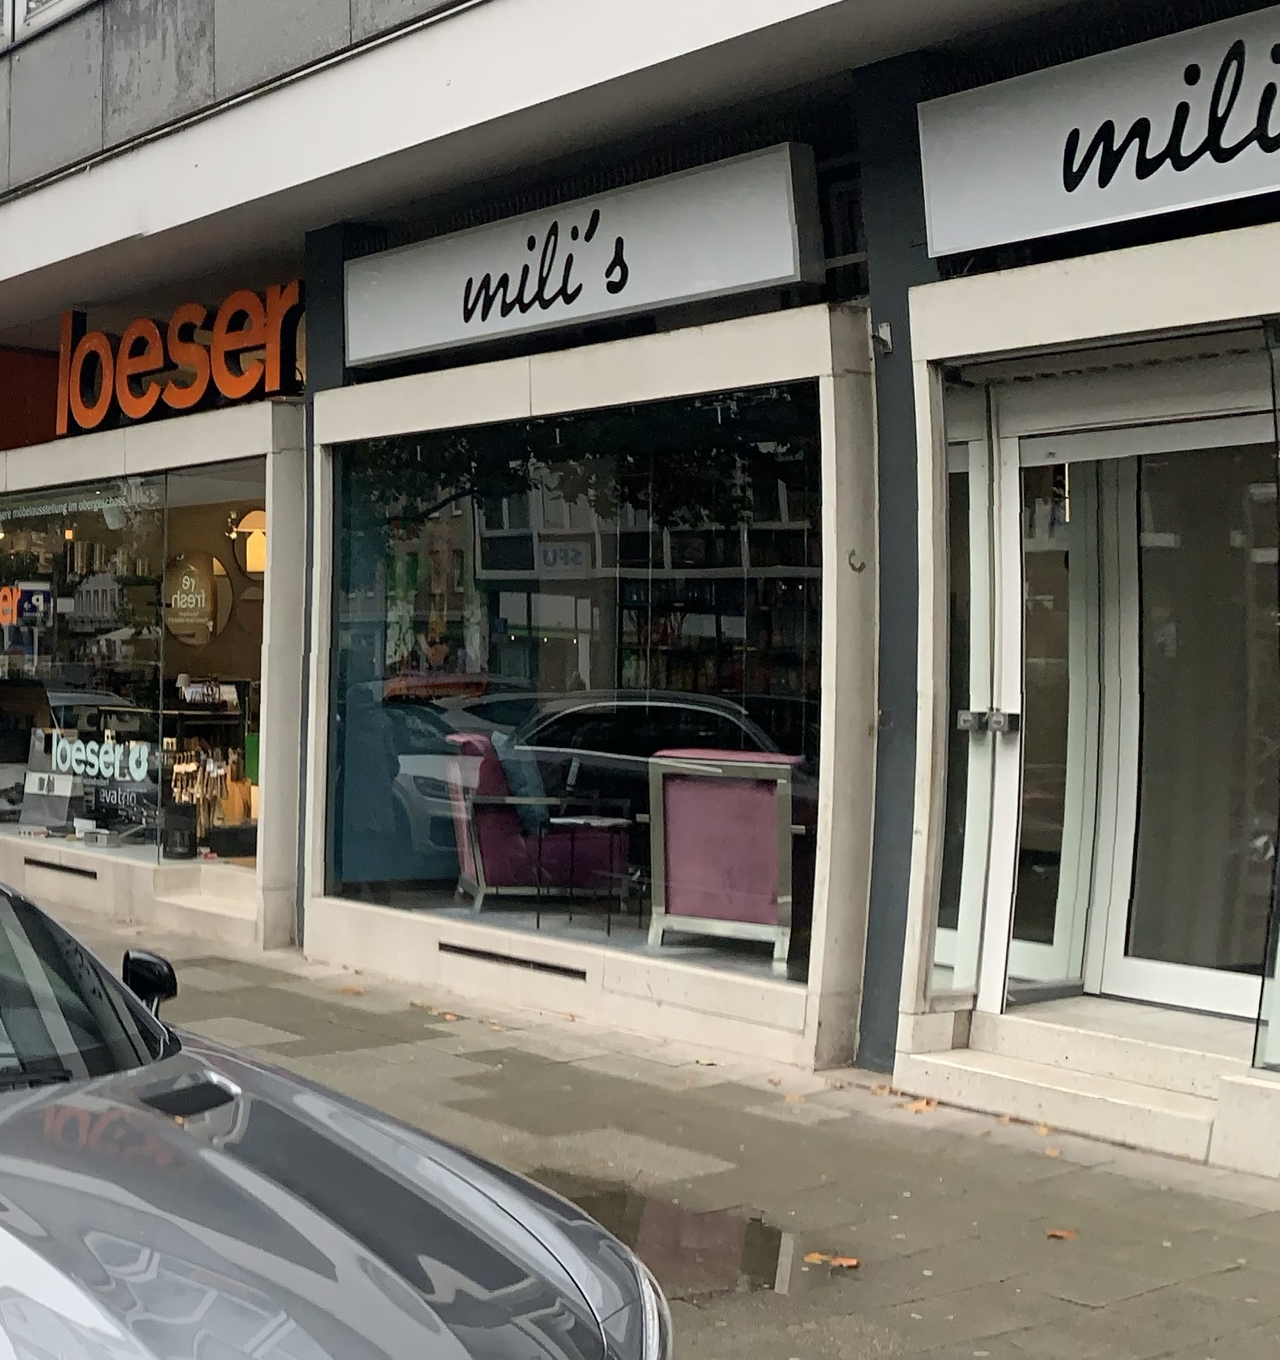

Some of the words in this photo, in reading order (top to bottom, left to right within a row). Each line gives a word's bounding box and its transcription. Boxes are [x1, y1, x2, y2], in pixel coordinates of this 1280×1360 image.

[463, 209, 628, 323] mili's
[56, 278, 300, 435] loeser
[52, 729, 124, 781] loeser
